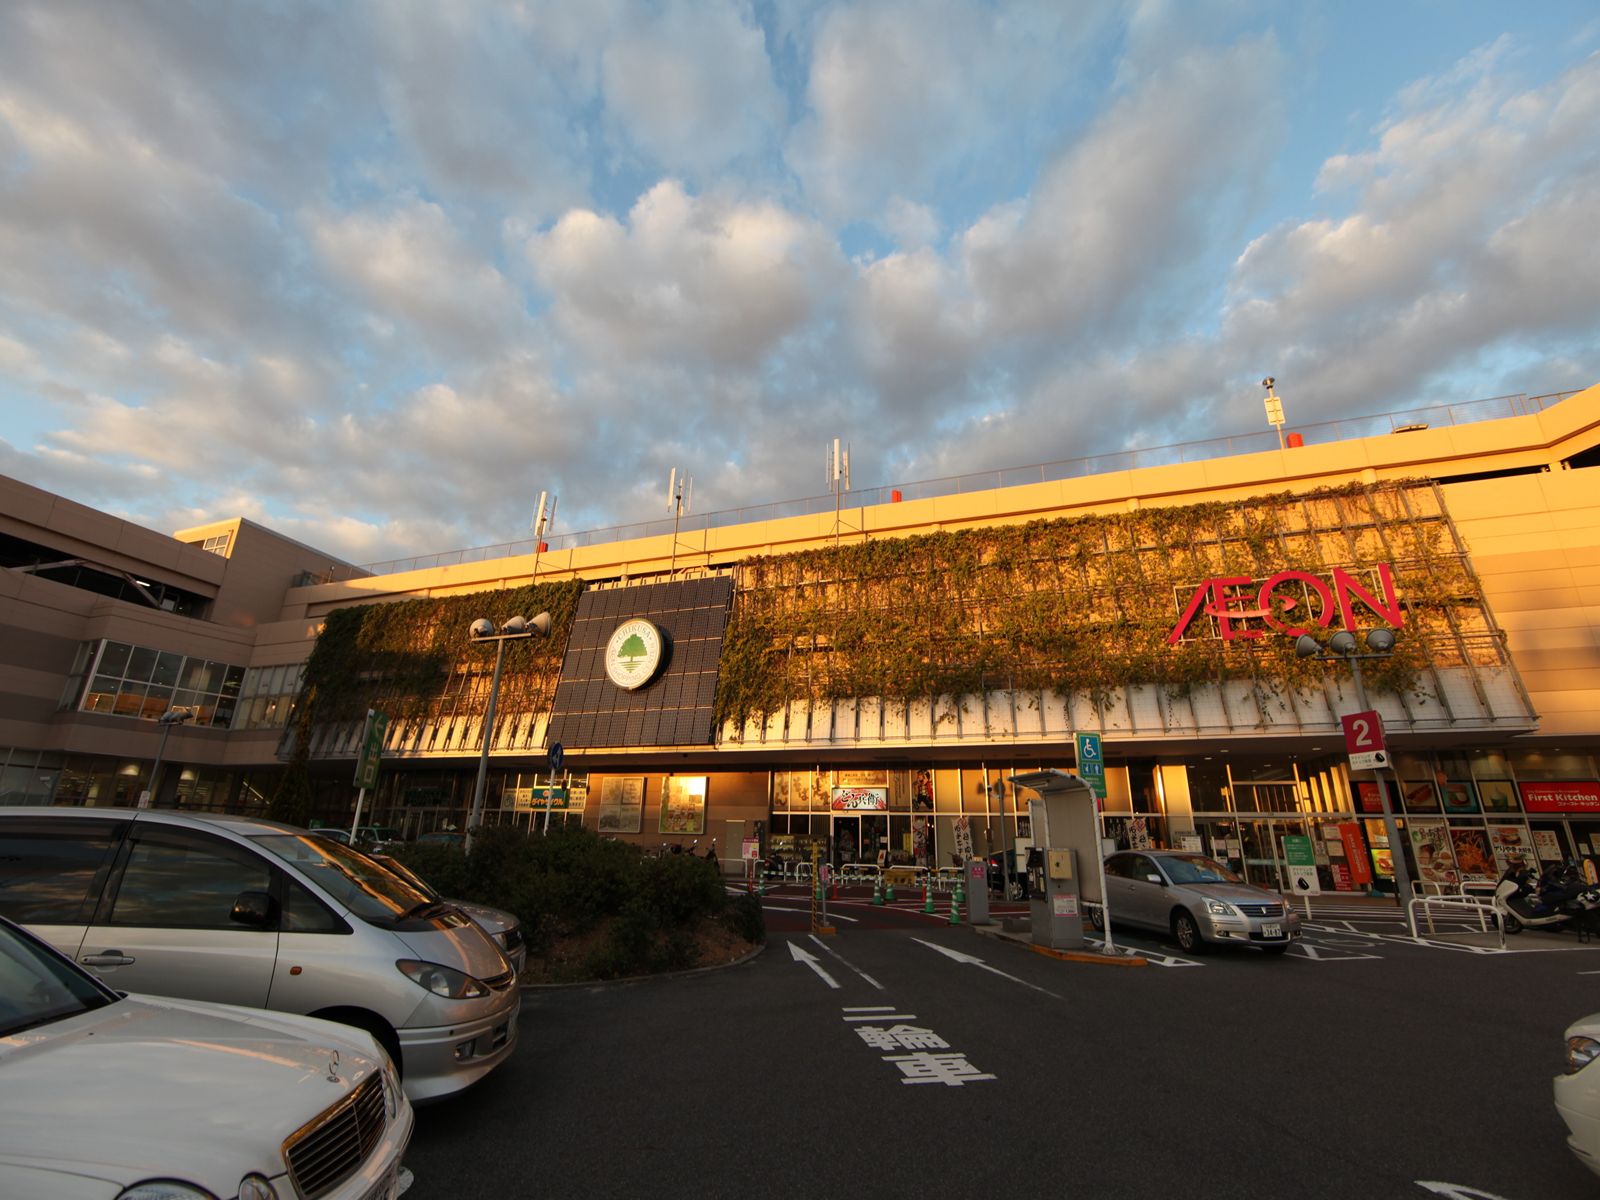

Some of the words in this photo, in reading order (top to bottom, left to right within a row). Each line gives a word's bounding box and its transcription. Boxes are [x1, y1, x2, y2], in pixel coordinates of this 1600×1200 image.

[1352, 719, 1373, 747] 2
[363, 742, 379, 784] 出口
[841, 788, 880, 809] どん兵衛
[1528, 793, 1554, 801] First
[1555, 793, 1599, 801] Kitchen
[841, 1006, 998, 1086] 二輪車
